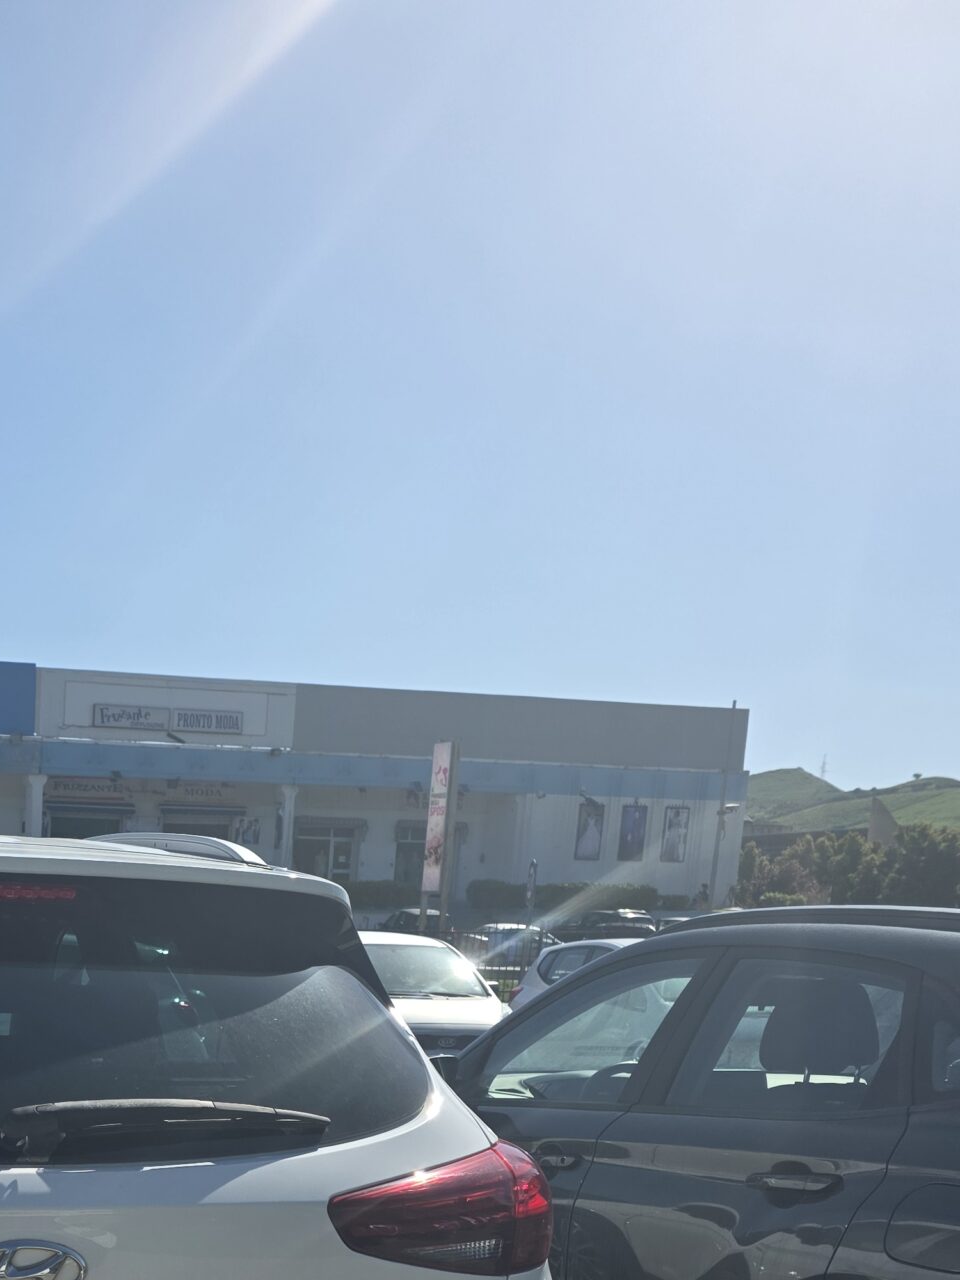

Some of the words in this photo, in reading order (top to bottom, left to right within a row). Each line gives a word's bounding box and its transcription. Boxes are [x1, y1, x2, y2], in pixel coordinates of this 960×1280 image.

[177, 712, 212, 729] PRONTO
[215, 714, 240, 730] MODA
[185, 788, 222, 797] MODA
